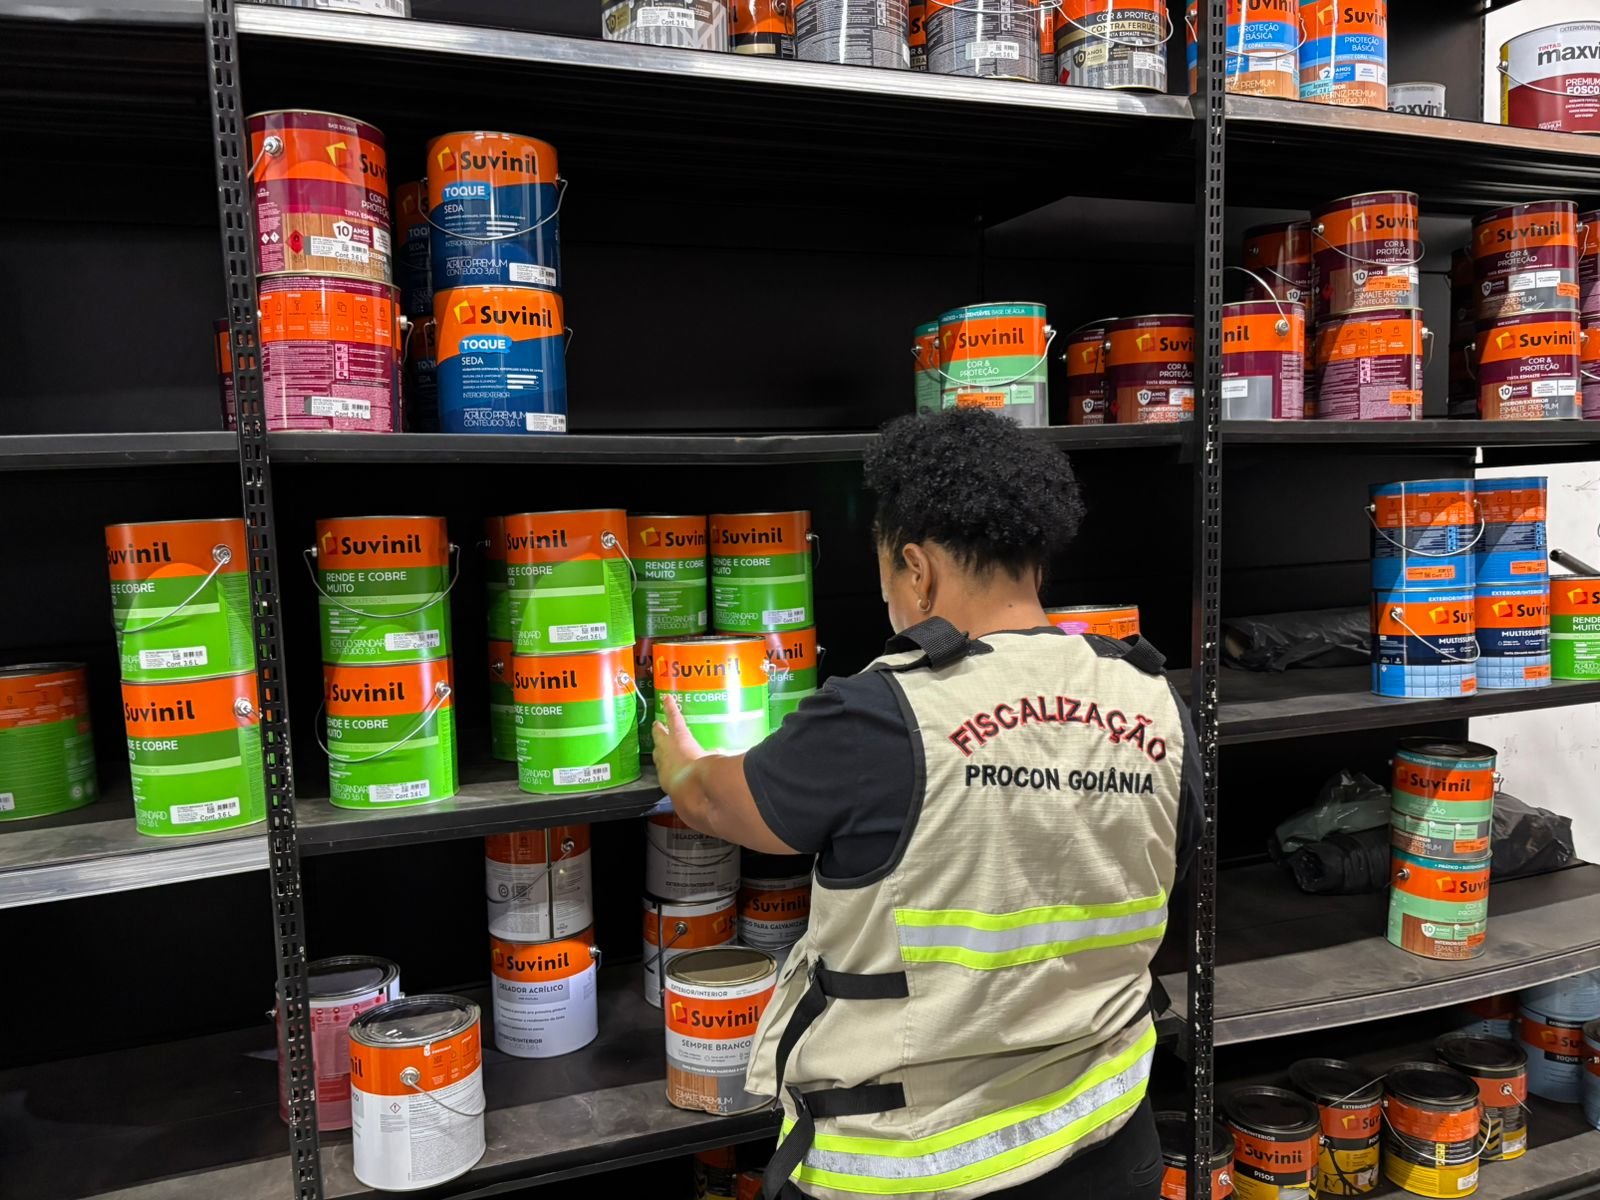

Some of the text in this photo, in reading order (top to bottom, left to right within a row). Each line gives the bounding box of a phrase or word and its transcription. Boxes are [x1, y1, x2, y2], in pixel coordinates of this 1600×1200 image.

[1246, 31, 1272, 40] BÁSICA
[1344, 36, 1379, 46] PROTEÇÃO
[1352, 44, 1375, 52] BÁSICA
[1074, 52, 1085, 63] 10
[1323, 70, 1330, 78] 2
[1566, 86, 1600, 94] FOSCO
[460, 150, 538, 176] Suvinil
[445, 186, 486, 198] TOQUE
[444, 204, 464, 214] SEDA
[336, 226, 350, 237] 10
[1496, 221, 1560, 242] Suvinil
[1384, 240, 1400, 248] COR
[1376, 247, 1411, 256] PROTEÇÃO
[1505, 250, 1520, 259] COR
[1497, 256, 1538, 267] PROTEÇÃO
[1355, 272, 1366, 280] 10
[480, 306, 552, 328] Suvinil
[958, 328, 1024, 349] Suvinil
[1520, 330, 1576, 348] Suvinil
[462, 339, 506, 350] TOQUE
[1160, 337, 1193, 352] Suvi
[462, 356, 484, 366] SEDA
[966, 360, 983, 368] COR
[960, 366, 1000, 376] PROTEÇÃO
[1520, 363, 1560, 372] PROTEÇÃO
[1140, 392, 1149, 400] 10
[1500, 388, 1510, 396] 10
[506, 530, 568, 550] Suvinil
[665, 530, 705, 547] Suvin
[722, 528, 783, 544] Suvinil
[342, 534, 422, 555] Suvinil
[646, 561, 676, 570] RENDE
[685, 560, 704, 568] COBRE
[734, 558, 771, 566] E COBRE
[326, 571, 407, 582] RENDE E COBRE
[522, 566, 553, 576] COBRE
[646, 570, 676, 578] MUITO
[122, 582, 156, 593] COBRE
[326, 583, 354, 593] MUITO
[672, 658, 741, 678] Suvinil
[515, 670, 578, 690] Suvinil
[332, 682, 404, 702] Suvinil
[686, 692, 728, 702] E COBRE
[126, 700, 195, 722] Suvinil
[531, 706, 563, 716] COBRE
[344, 719, 388, 729] E COBRE
[948, 696, 1168, 762] FISCALIZAÇÃO
[142, 740, 178, 751] COBRE
[965, 764, 1154, 794] PROCON GOIÂNIA
[1410, 773, 1471, 792] Suvinil
[754, 922, 770, 930] PARA
[506, 952, 570, 972] Suvinil
[499, 982, 564, 994] SELADOR ACRÍLICO
[671, 983, 728, 998] EXTERIOR/INTERIOR
[691, 1006, 760, 1028] Suvinil
[682, 1040, 751, 1051] SEMPRE BRANCO
[1245, 1144, 1302, 1164] Suvinil
[1254, 1170, 1275, 1182] PISOS
